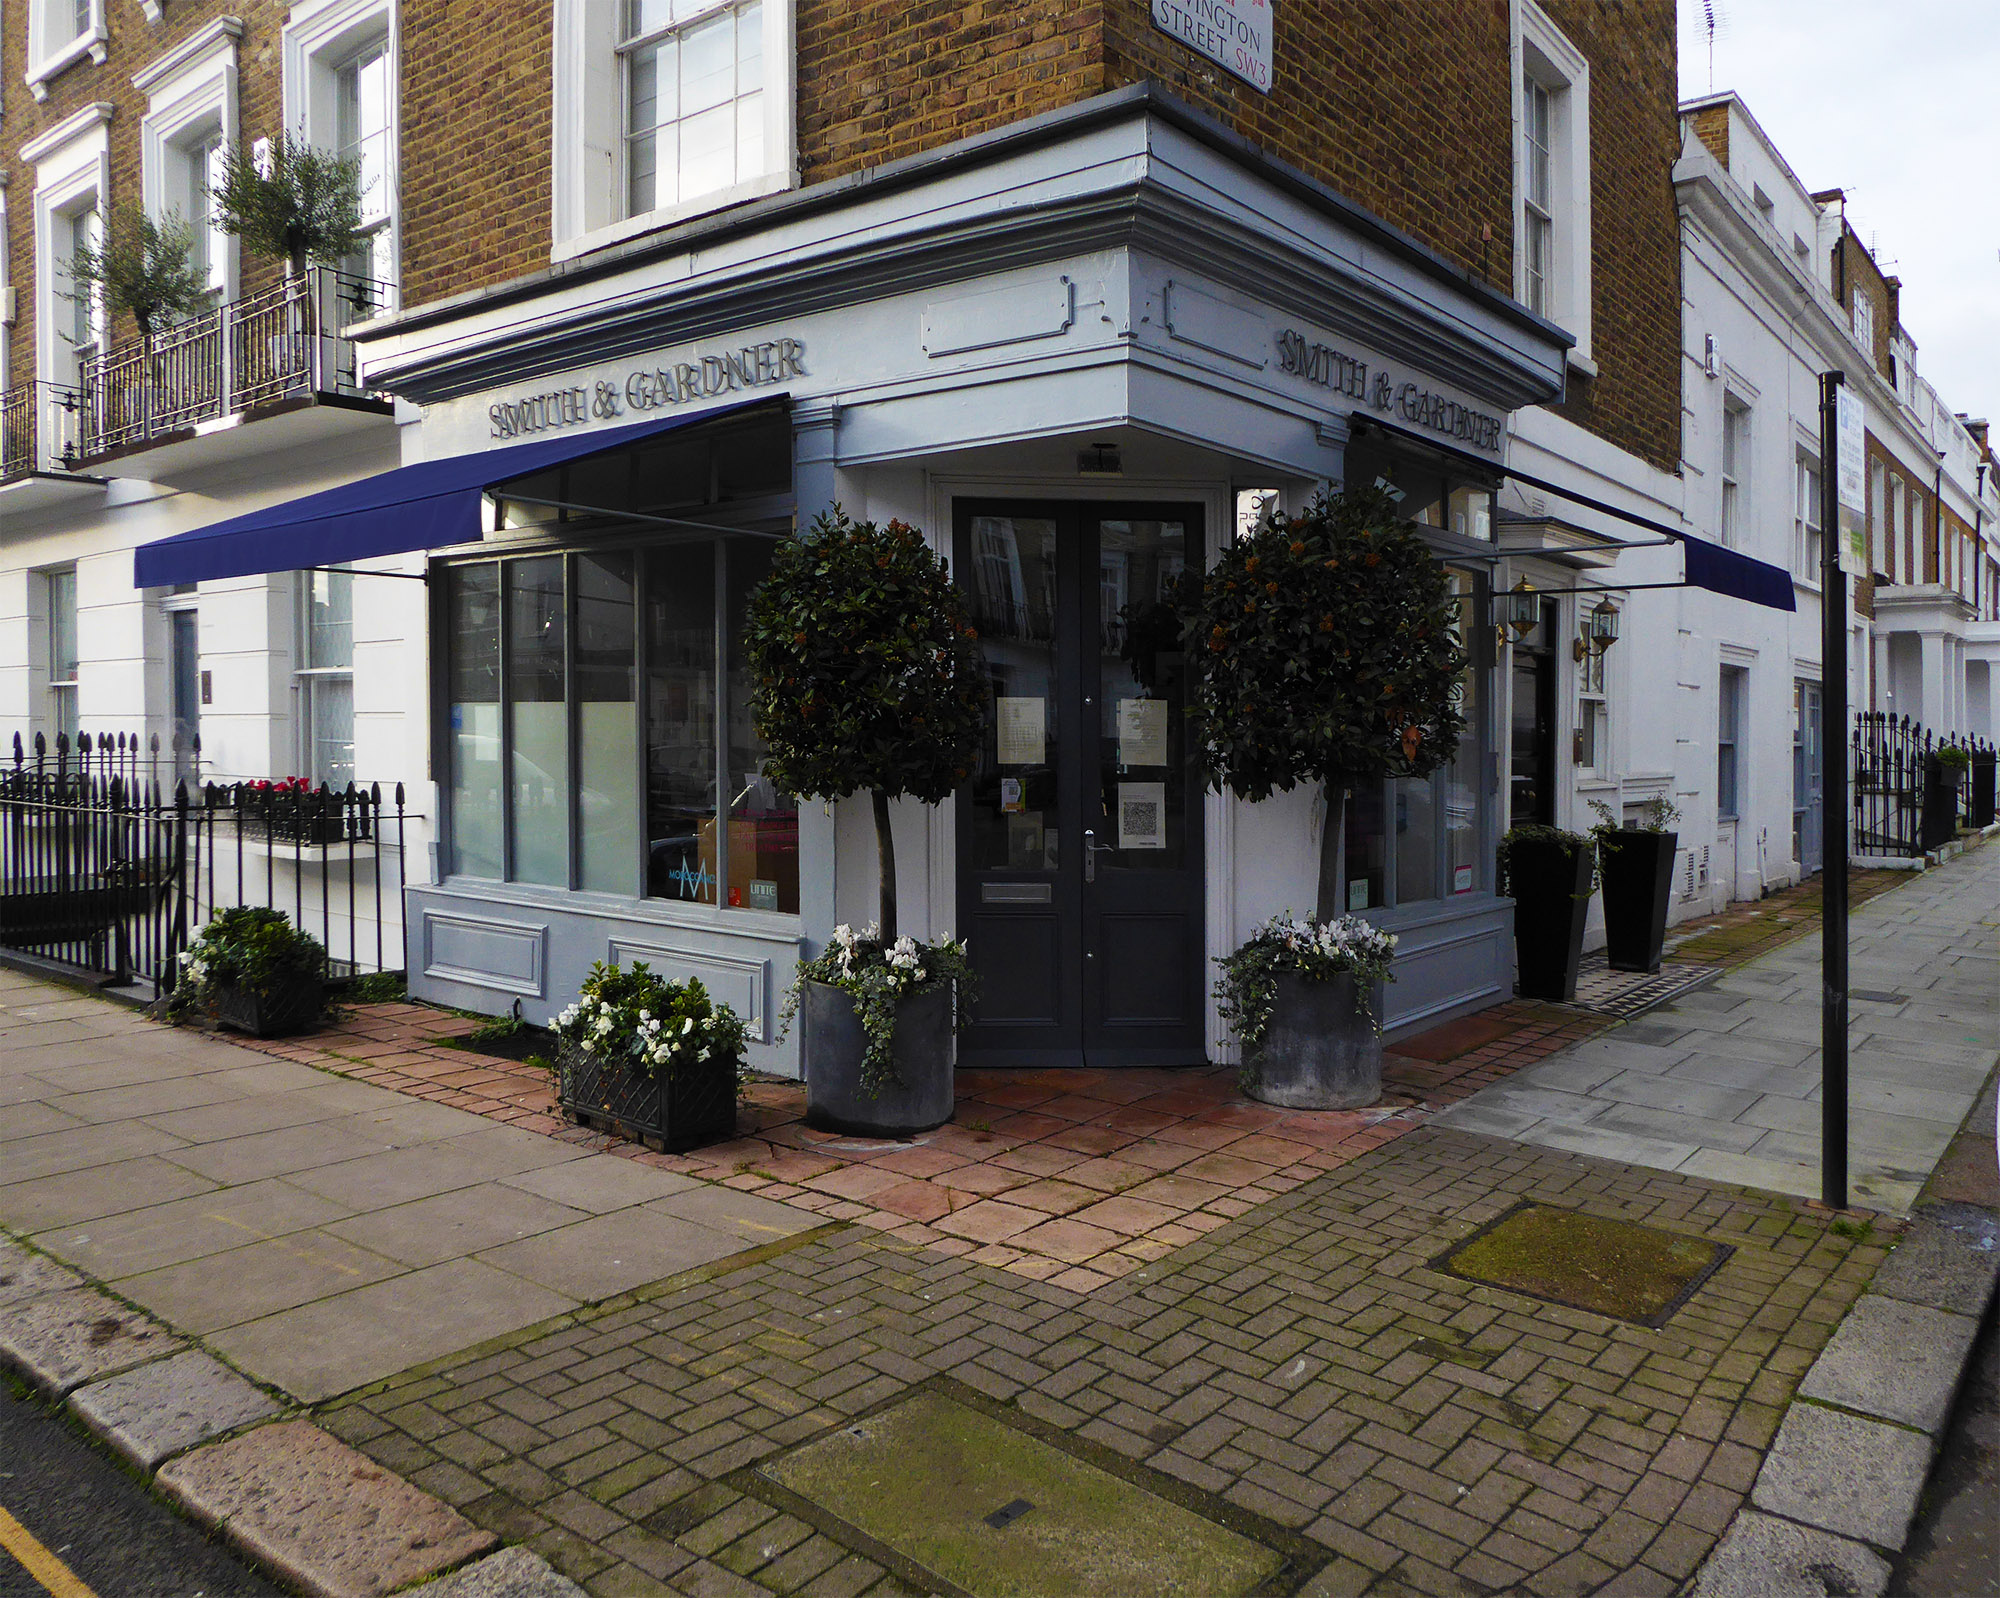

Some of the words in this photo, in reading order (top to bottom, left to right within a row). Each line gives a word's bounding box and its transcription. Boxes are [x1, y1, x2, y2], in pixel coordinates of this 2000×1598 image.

[488, 385, 588, 440] SMITH
[591, 380, 618, 419] &
[625, 337, 804, 411] GARDNER
[1279, 328, 1368, 401] SMITH
[1375, 371, 1394, 412] &
[1398, 382, 1501, 454] GARDNER
